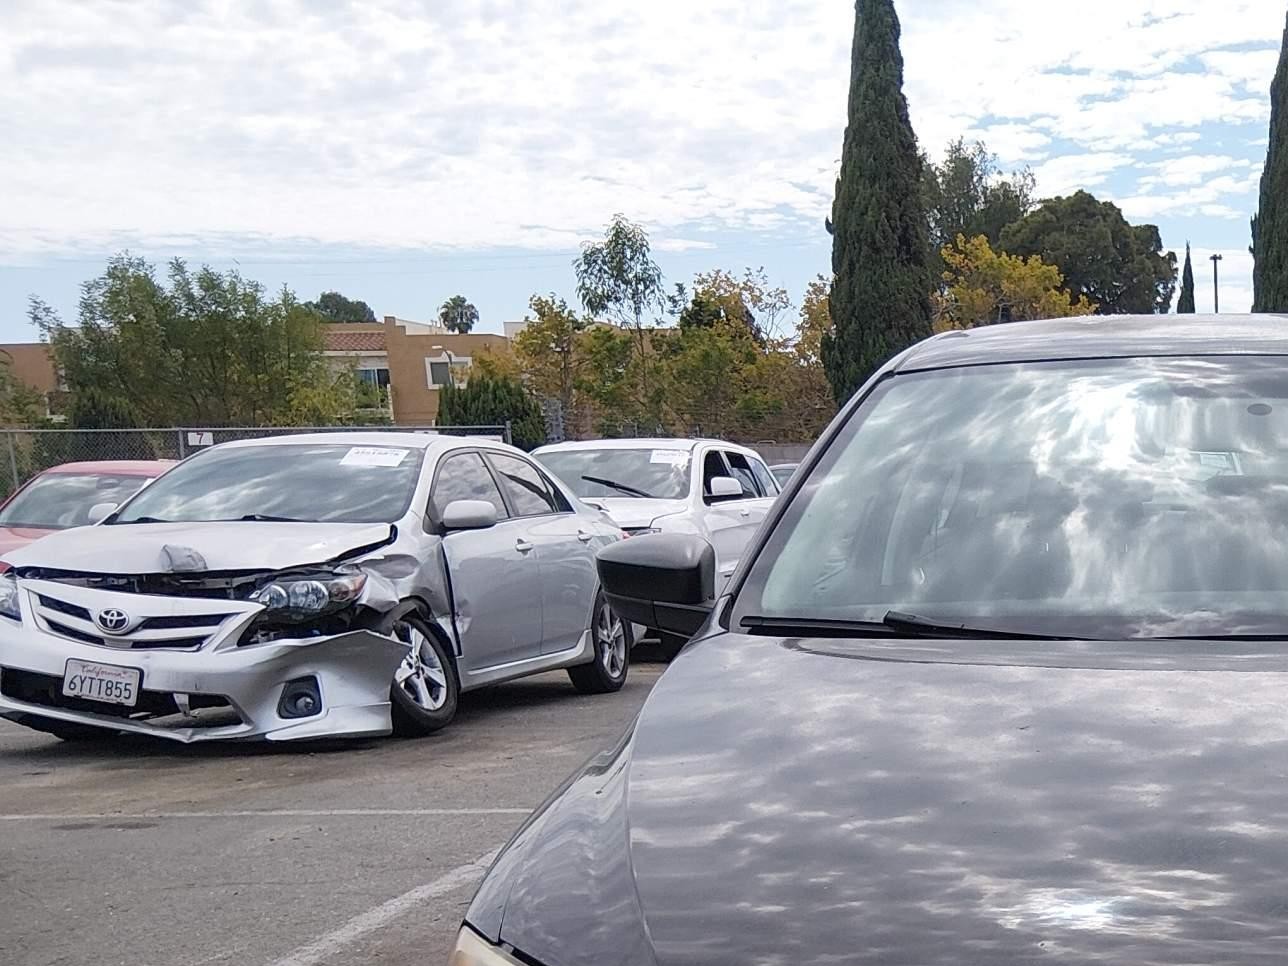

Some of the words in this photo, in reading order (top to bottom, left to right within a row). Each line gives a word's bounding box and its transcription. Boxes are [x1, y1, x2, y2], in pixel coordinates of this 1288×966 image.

[196, 432, 204, 445] 7
[81, 664, 128, 677] California
[68, 674, 132, 700] 6YTT855
